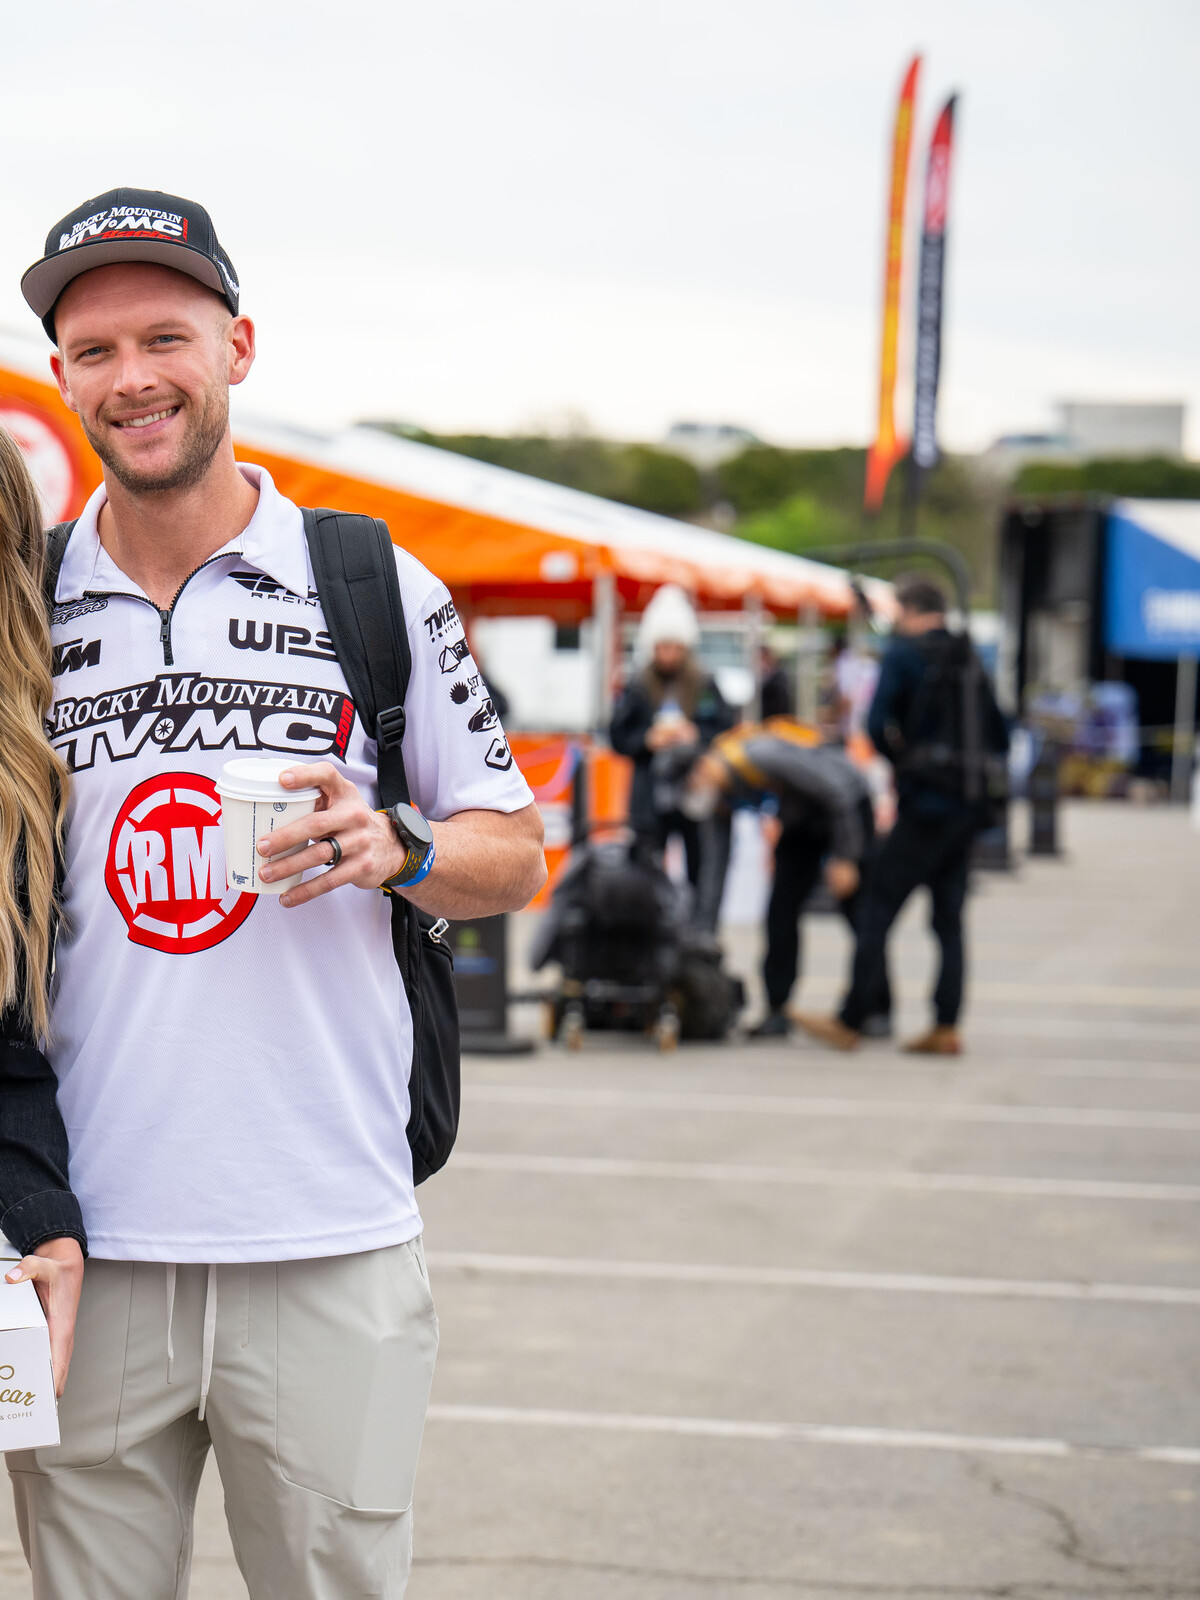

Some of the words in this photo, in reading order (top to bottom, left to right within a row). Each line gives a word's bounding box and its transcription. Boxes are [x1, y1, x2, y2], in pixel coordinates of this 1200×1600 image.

[71, 211, 108, 236] ROCKY
[109, 206, 182, 223] MOUNTAIN
[251, 592, 317, 607] RACIN
[424, 600, 456, 636] TWIS
[52, 637, 102, 678] TM
[55, 687, 149, 732] ROCKY
[152, 678, 339, 714] MOUNTAIN
[7, 1411, 33, 1420] COFFEE
